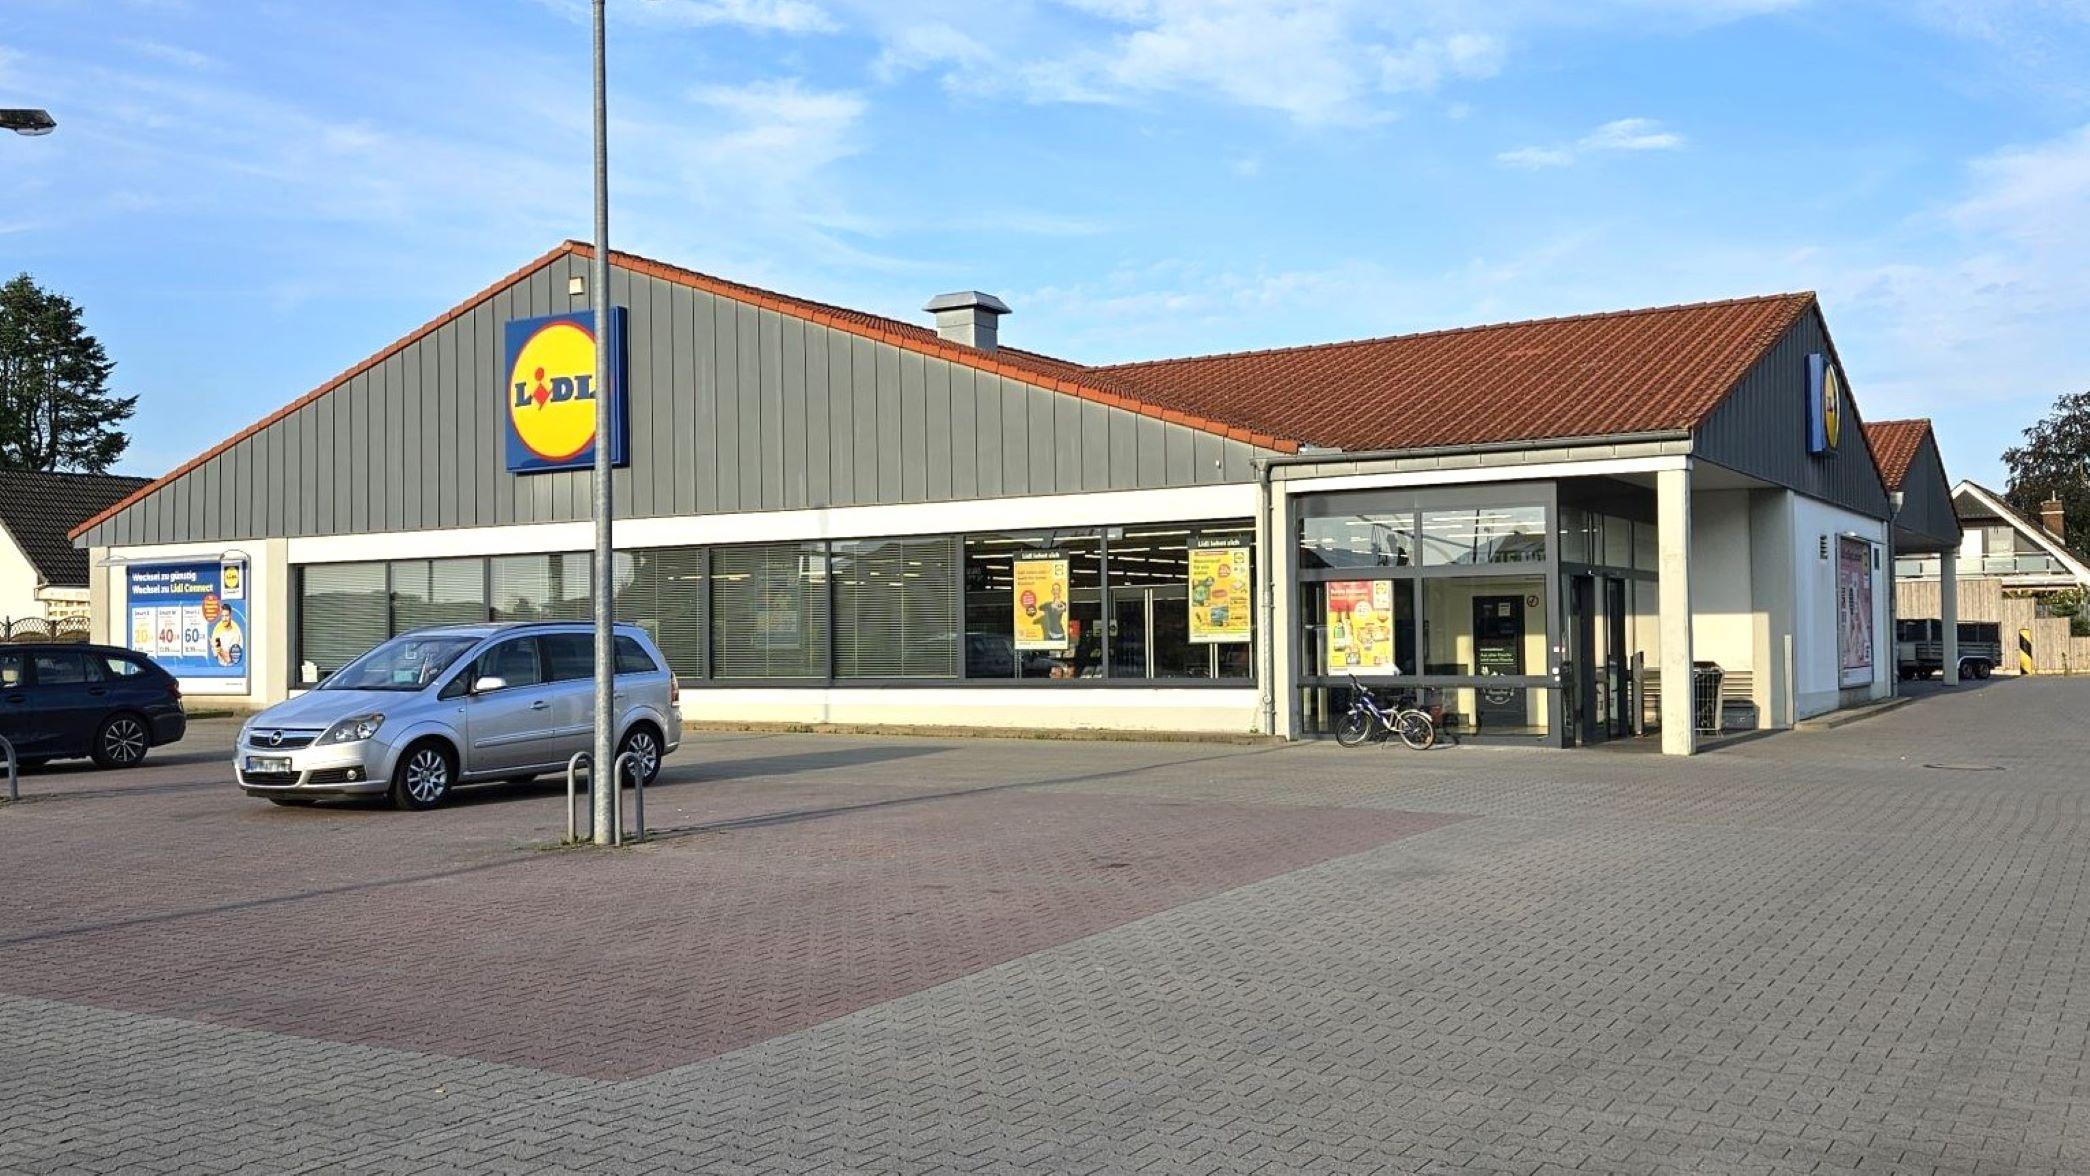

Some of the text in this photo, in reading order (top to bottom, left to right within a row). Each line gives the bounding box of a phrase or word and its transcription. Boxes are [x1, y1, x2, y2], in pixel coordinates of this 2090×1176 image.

[132, 570, 196, 582] Wechsel zu günstig
[132, 584, 160, 594] Wechsel
[161, 585, 169, 593] zu
[170, 583, 183, 593] Lidl
[184, 583, 213, 593] Connect
[159, 629, 173, 643] 40
[185, 628, 199, 642] 60
